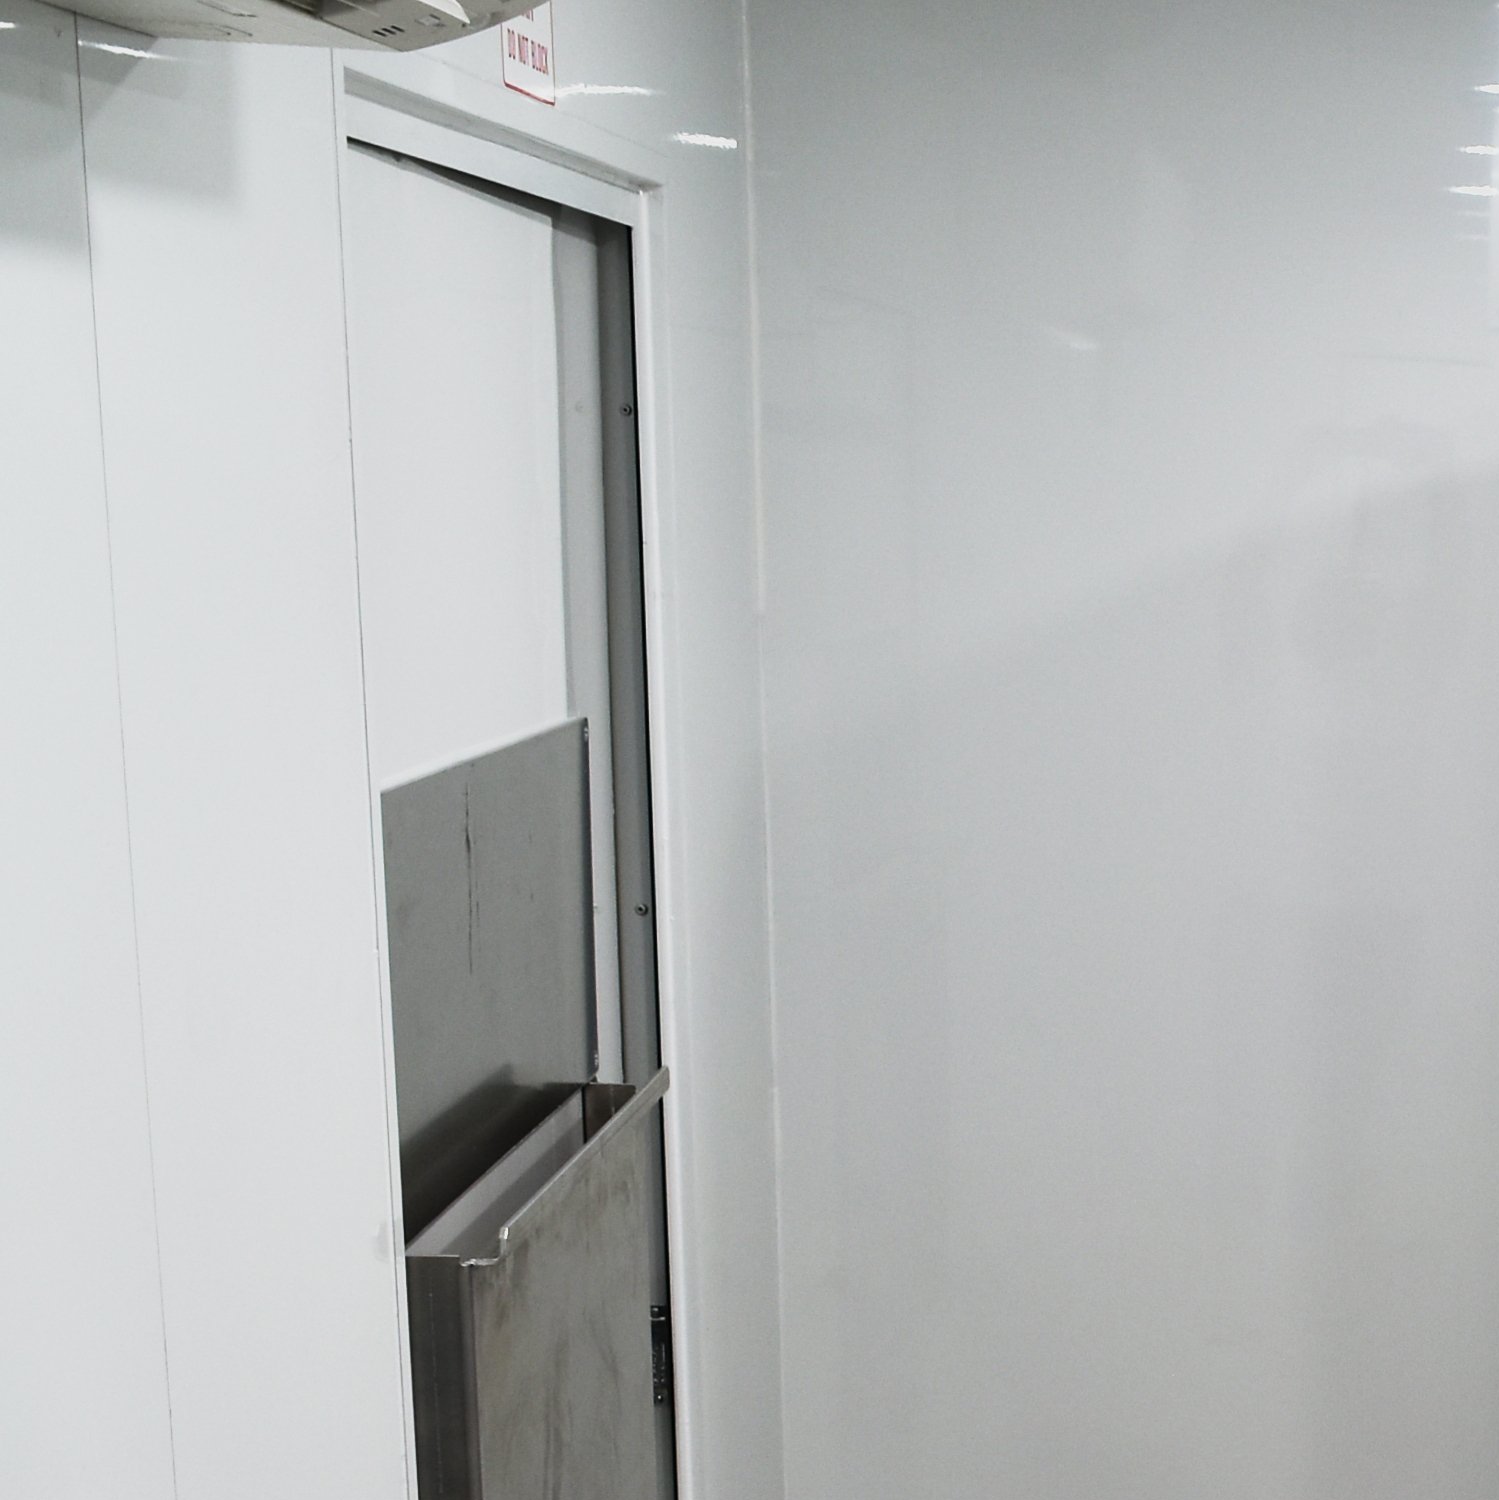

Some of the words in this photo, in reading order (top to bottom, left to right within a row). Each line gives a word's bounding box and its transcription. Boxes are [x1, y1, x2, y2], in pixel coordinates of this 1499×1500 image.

[507, 28, 516, 59] DO
[518, 33, 529, 66] NOT
[531, 40, 549, 75] BLOCK
